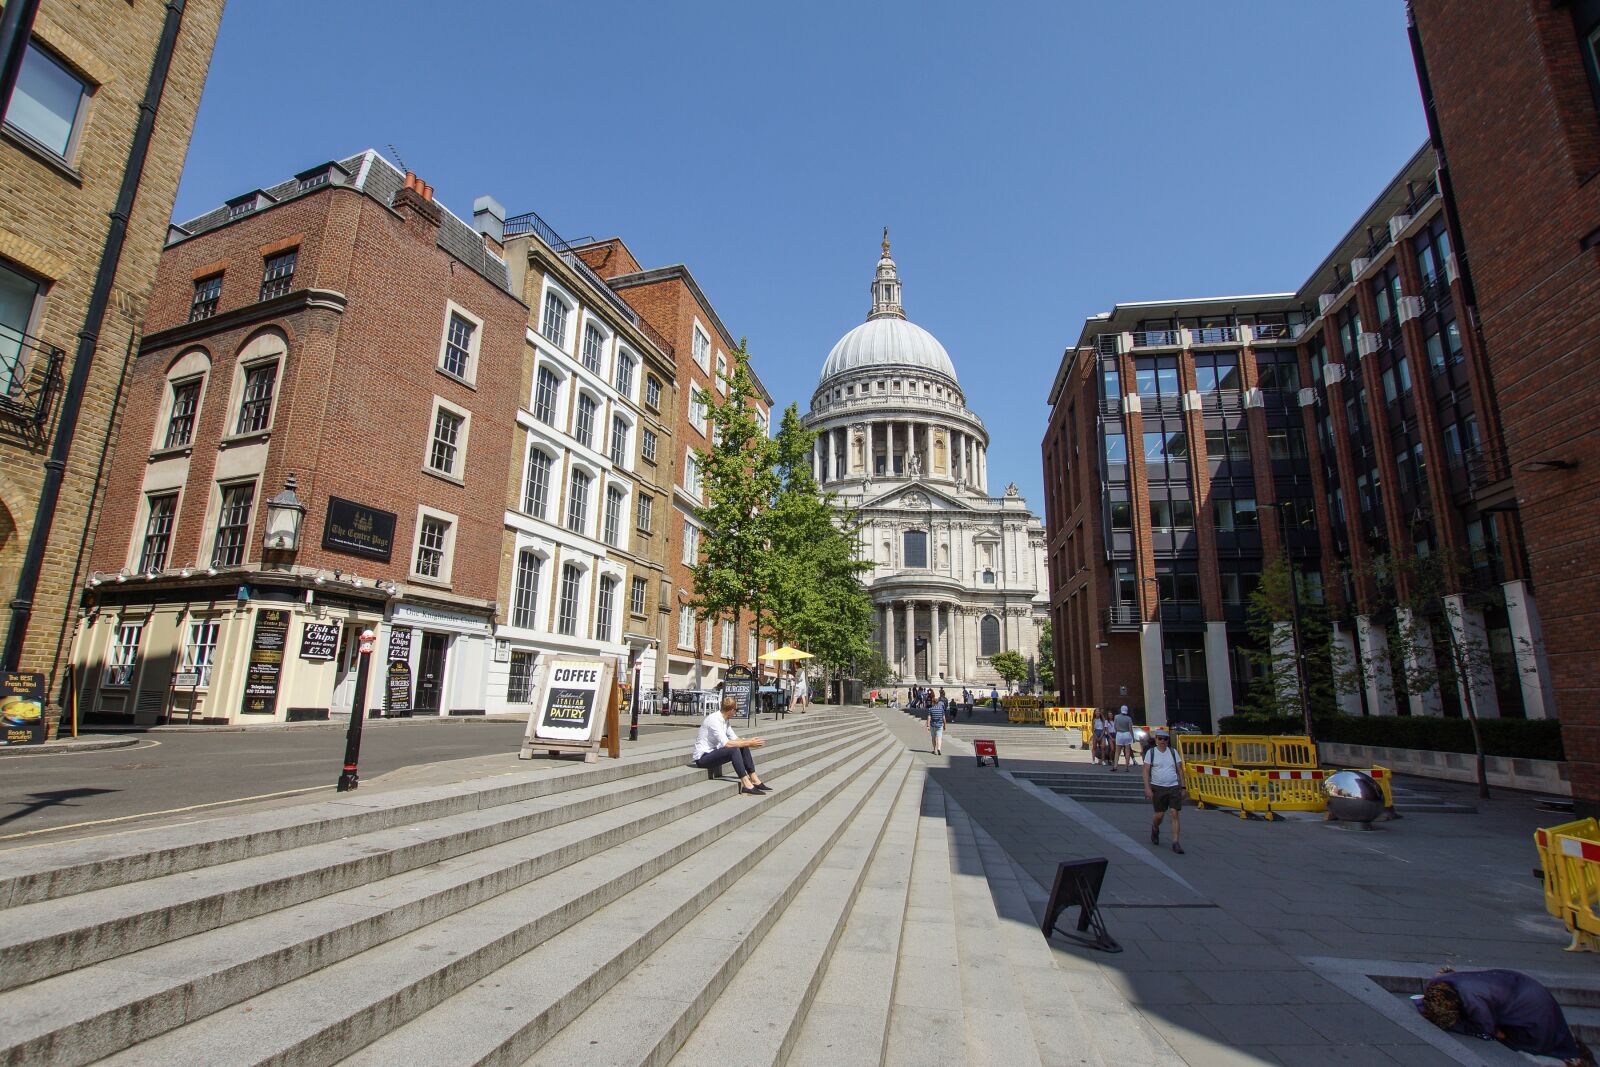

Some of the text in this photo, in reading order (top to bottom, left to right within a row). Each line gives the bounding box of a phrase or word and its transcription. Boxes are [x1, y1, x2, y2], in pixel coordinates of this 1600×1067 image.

[331, 524, 346, 536] The
[371, 535, 389, 546] Page
[406, 608, 478, 625] One Knightrider Court
[306, 624, 328, 633] Fish
[308, 632, 335, 642] Chips
[392, 638, 408, 646] Chips
[308, 646, 330, 654] £7.50
[554, 668, 597, 682] COFFEE
